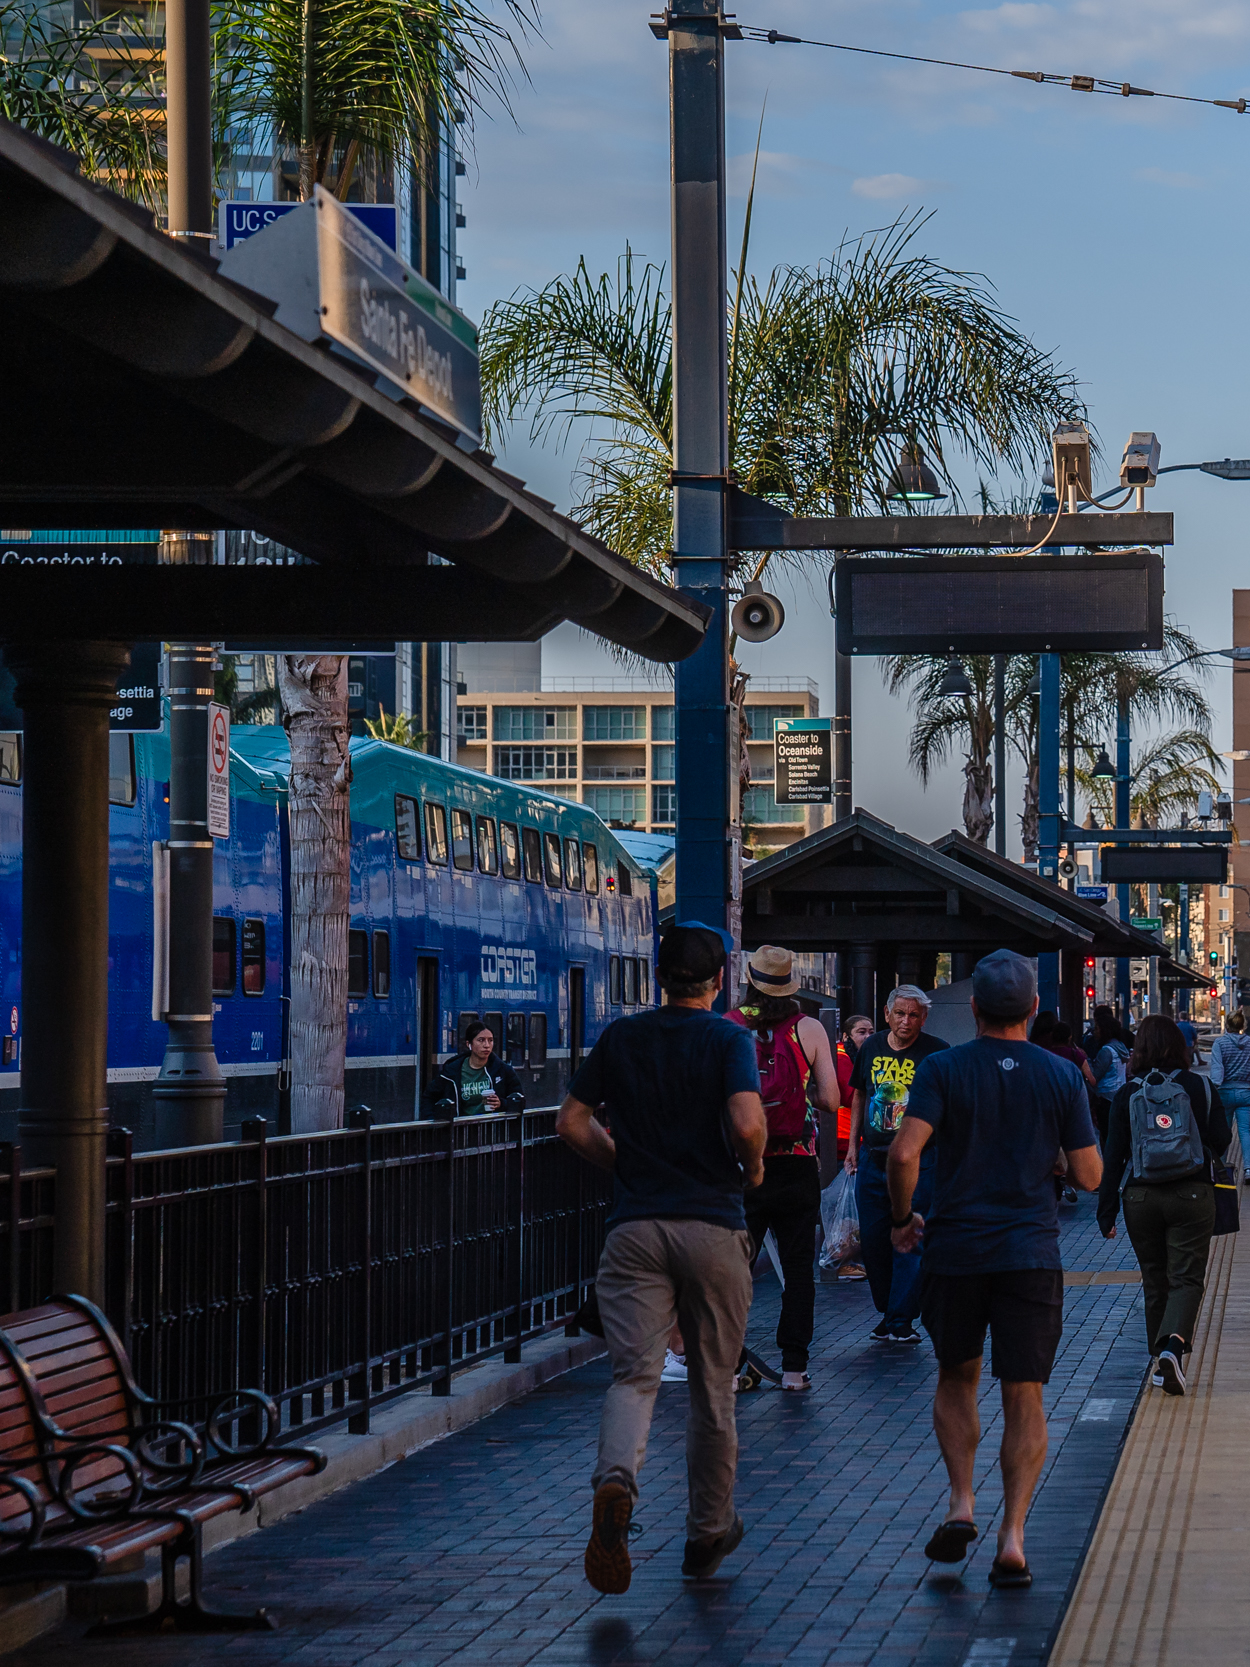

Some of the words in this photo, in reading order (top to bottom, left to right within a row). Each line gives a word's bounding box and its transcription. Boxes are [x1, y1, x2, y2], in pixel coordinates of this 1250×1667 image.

[233, 210, 260, 232] UC
[263, 210, 284, 231] S
[360, 277, 398, 360] Santa
[399, 310, 416, 373] Fe
[417, 324, 453, 402] Depot
[116, 685, 155, 699] settia
[777, 732, 809, 744] Coaster
[810, 733, 819, 744] to
[778, 744, 823, 756] Oceanside
[481, 945, 537, 985] COASTER
[251, 1031, 263, 1051] 2201
[871, 1056, 915, 1072] STAR
[870, 1069, 916, 1085] WARS
